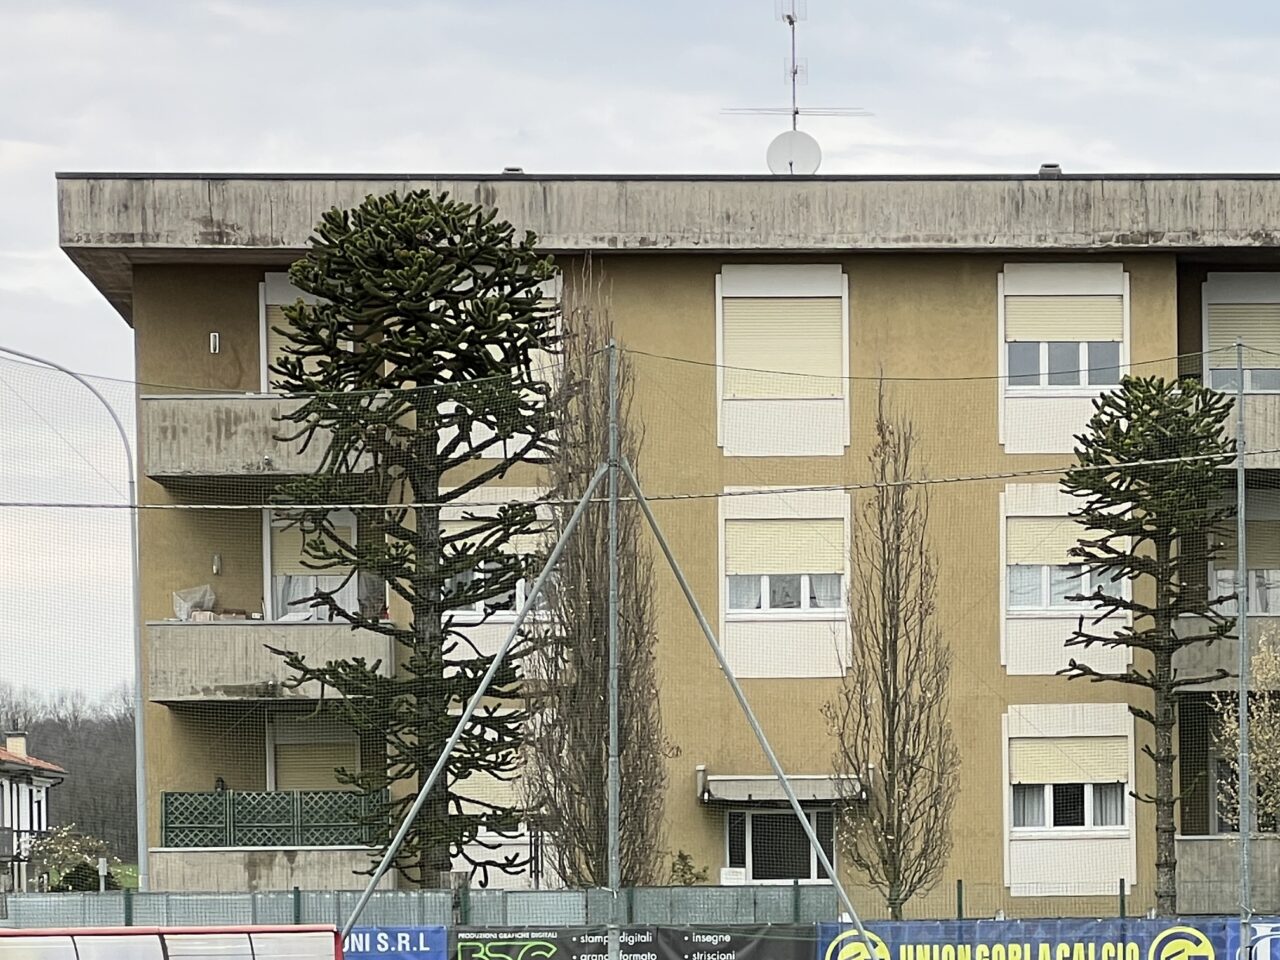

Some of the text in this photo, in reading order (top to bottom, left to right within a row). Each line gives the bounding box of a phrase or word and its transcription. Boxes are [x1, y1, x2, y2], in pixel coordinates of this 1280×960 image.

[376, 932, 430, 952] S.R.L
[619, 932, 653, 945] digitali
[692, 932, 731, 944] insegne
[692, 950, 736, 960] striscioni
